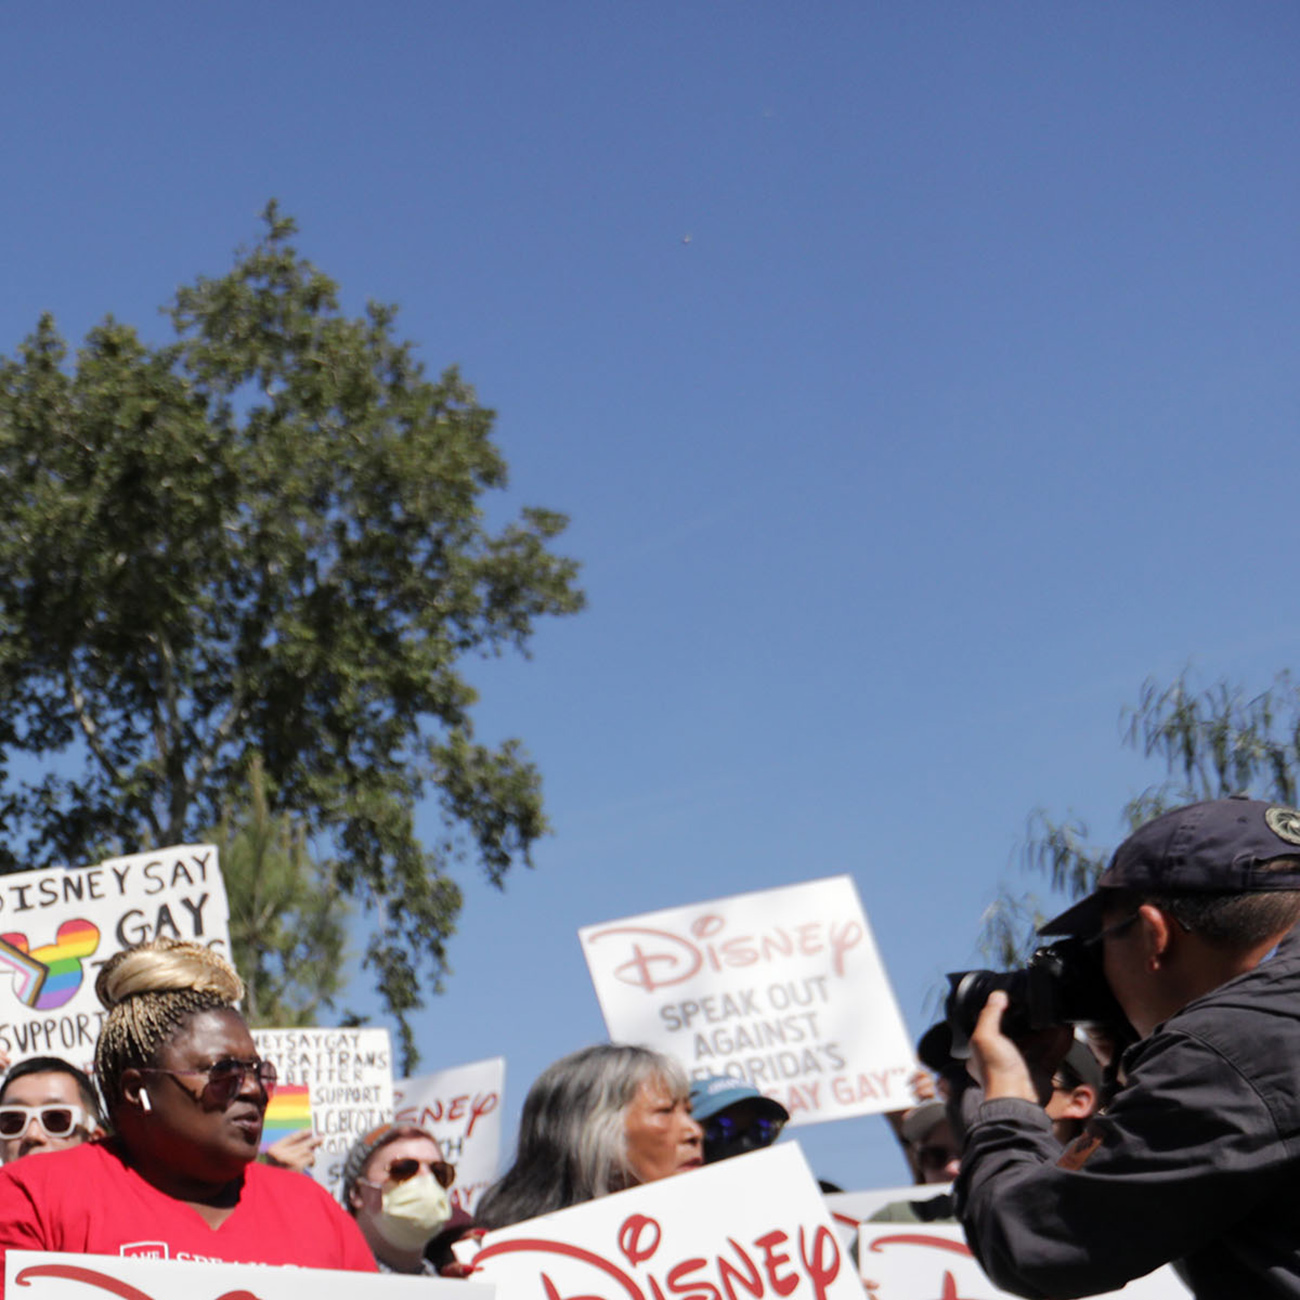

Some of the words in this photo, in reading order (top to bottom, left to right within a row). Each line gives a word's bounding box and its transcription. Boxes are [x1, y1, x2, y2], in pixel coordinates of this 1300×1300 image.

[143, 852, 211, 896] SAY
[116, 893, 209, 950] GAY
[659, 988, 759, 1033] SPEAK
[768, 975, 831, 1011] OUT
[693, 1011, 822, 1061] AGAINST
[312, 1086, 381, 1106] SUPPORT
[831, 1067, 908, 1107] GAY"
